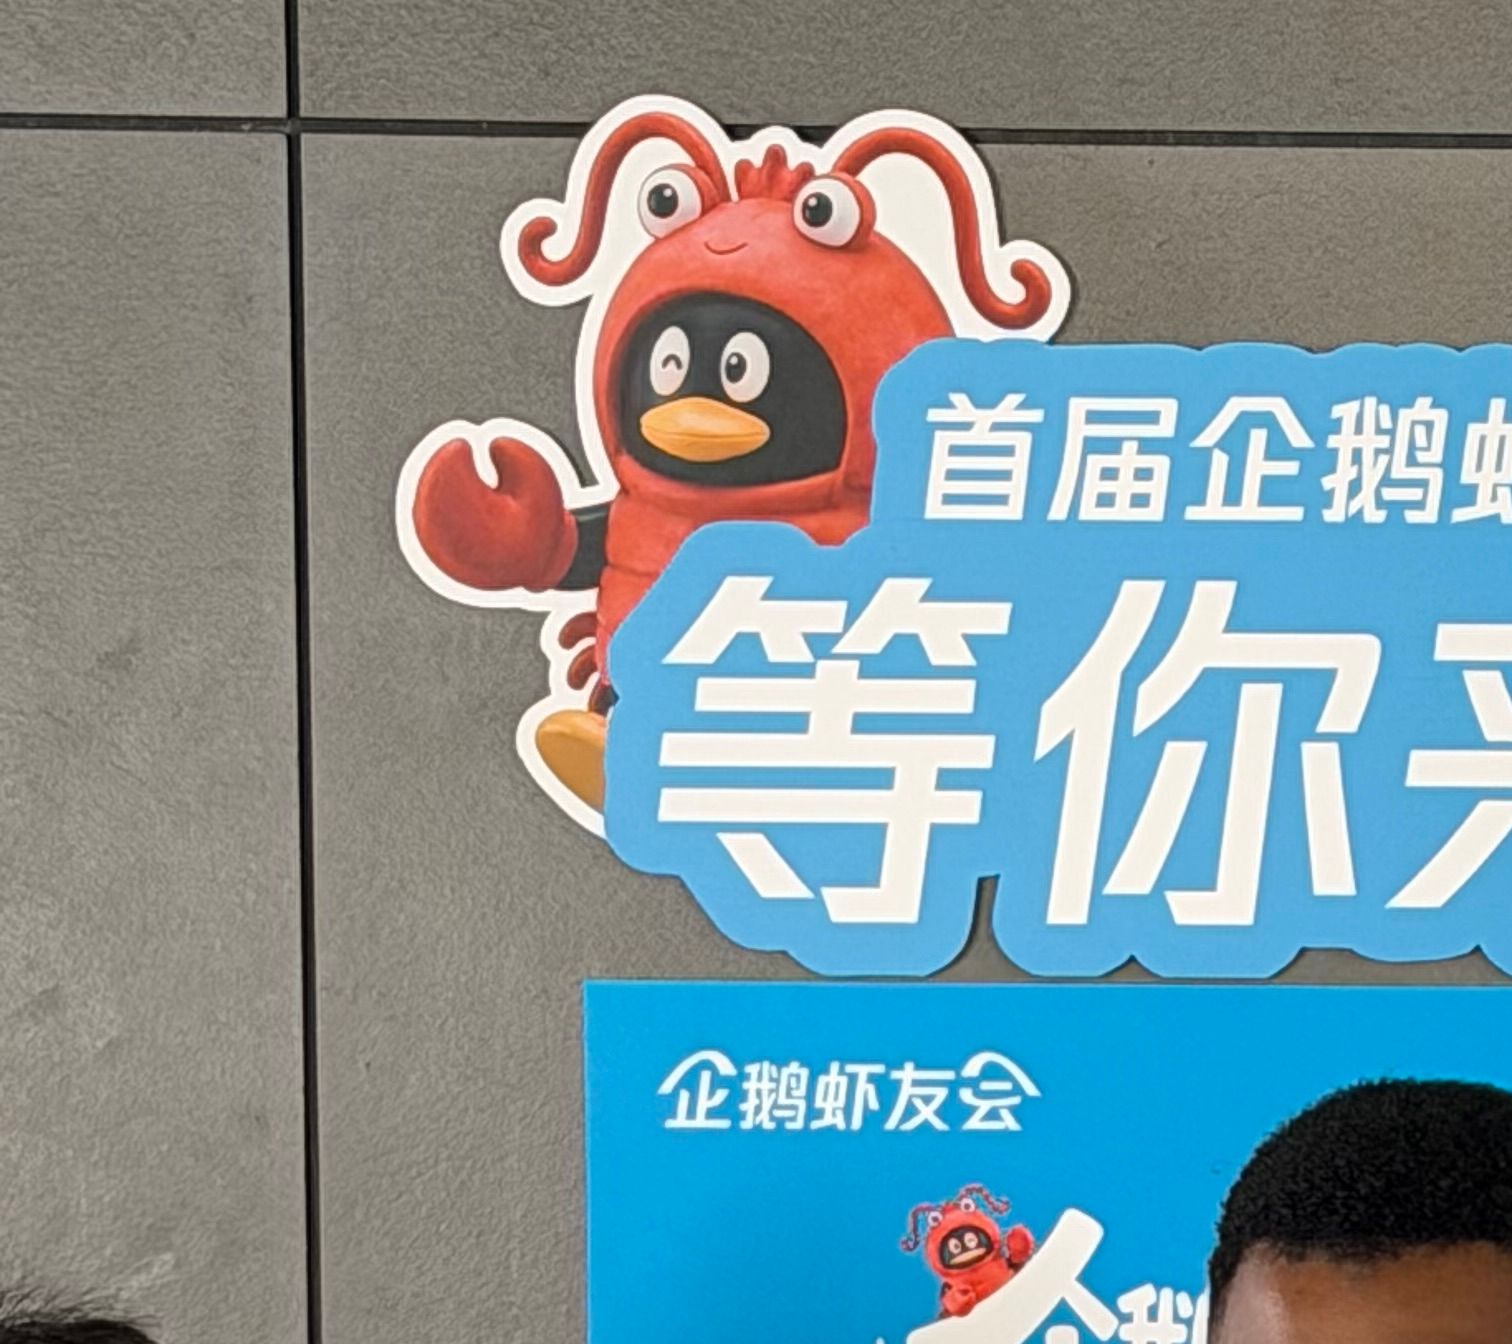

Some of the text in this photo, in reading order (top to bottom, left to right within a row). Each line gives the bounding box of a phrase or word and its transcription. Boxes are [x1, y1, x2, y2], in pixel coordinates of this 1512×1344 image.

[656, 1049, 1043, 1132] 企鹅虾友会
